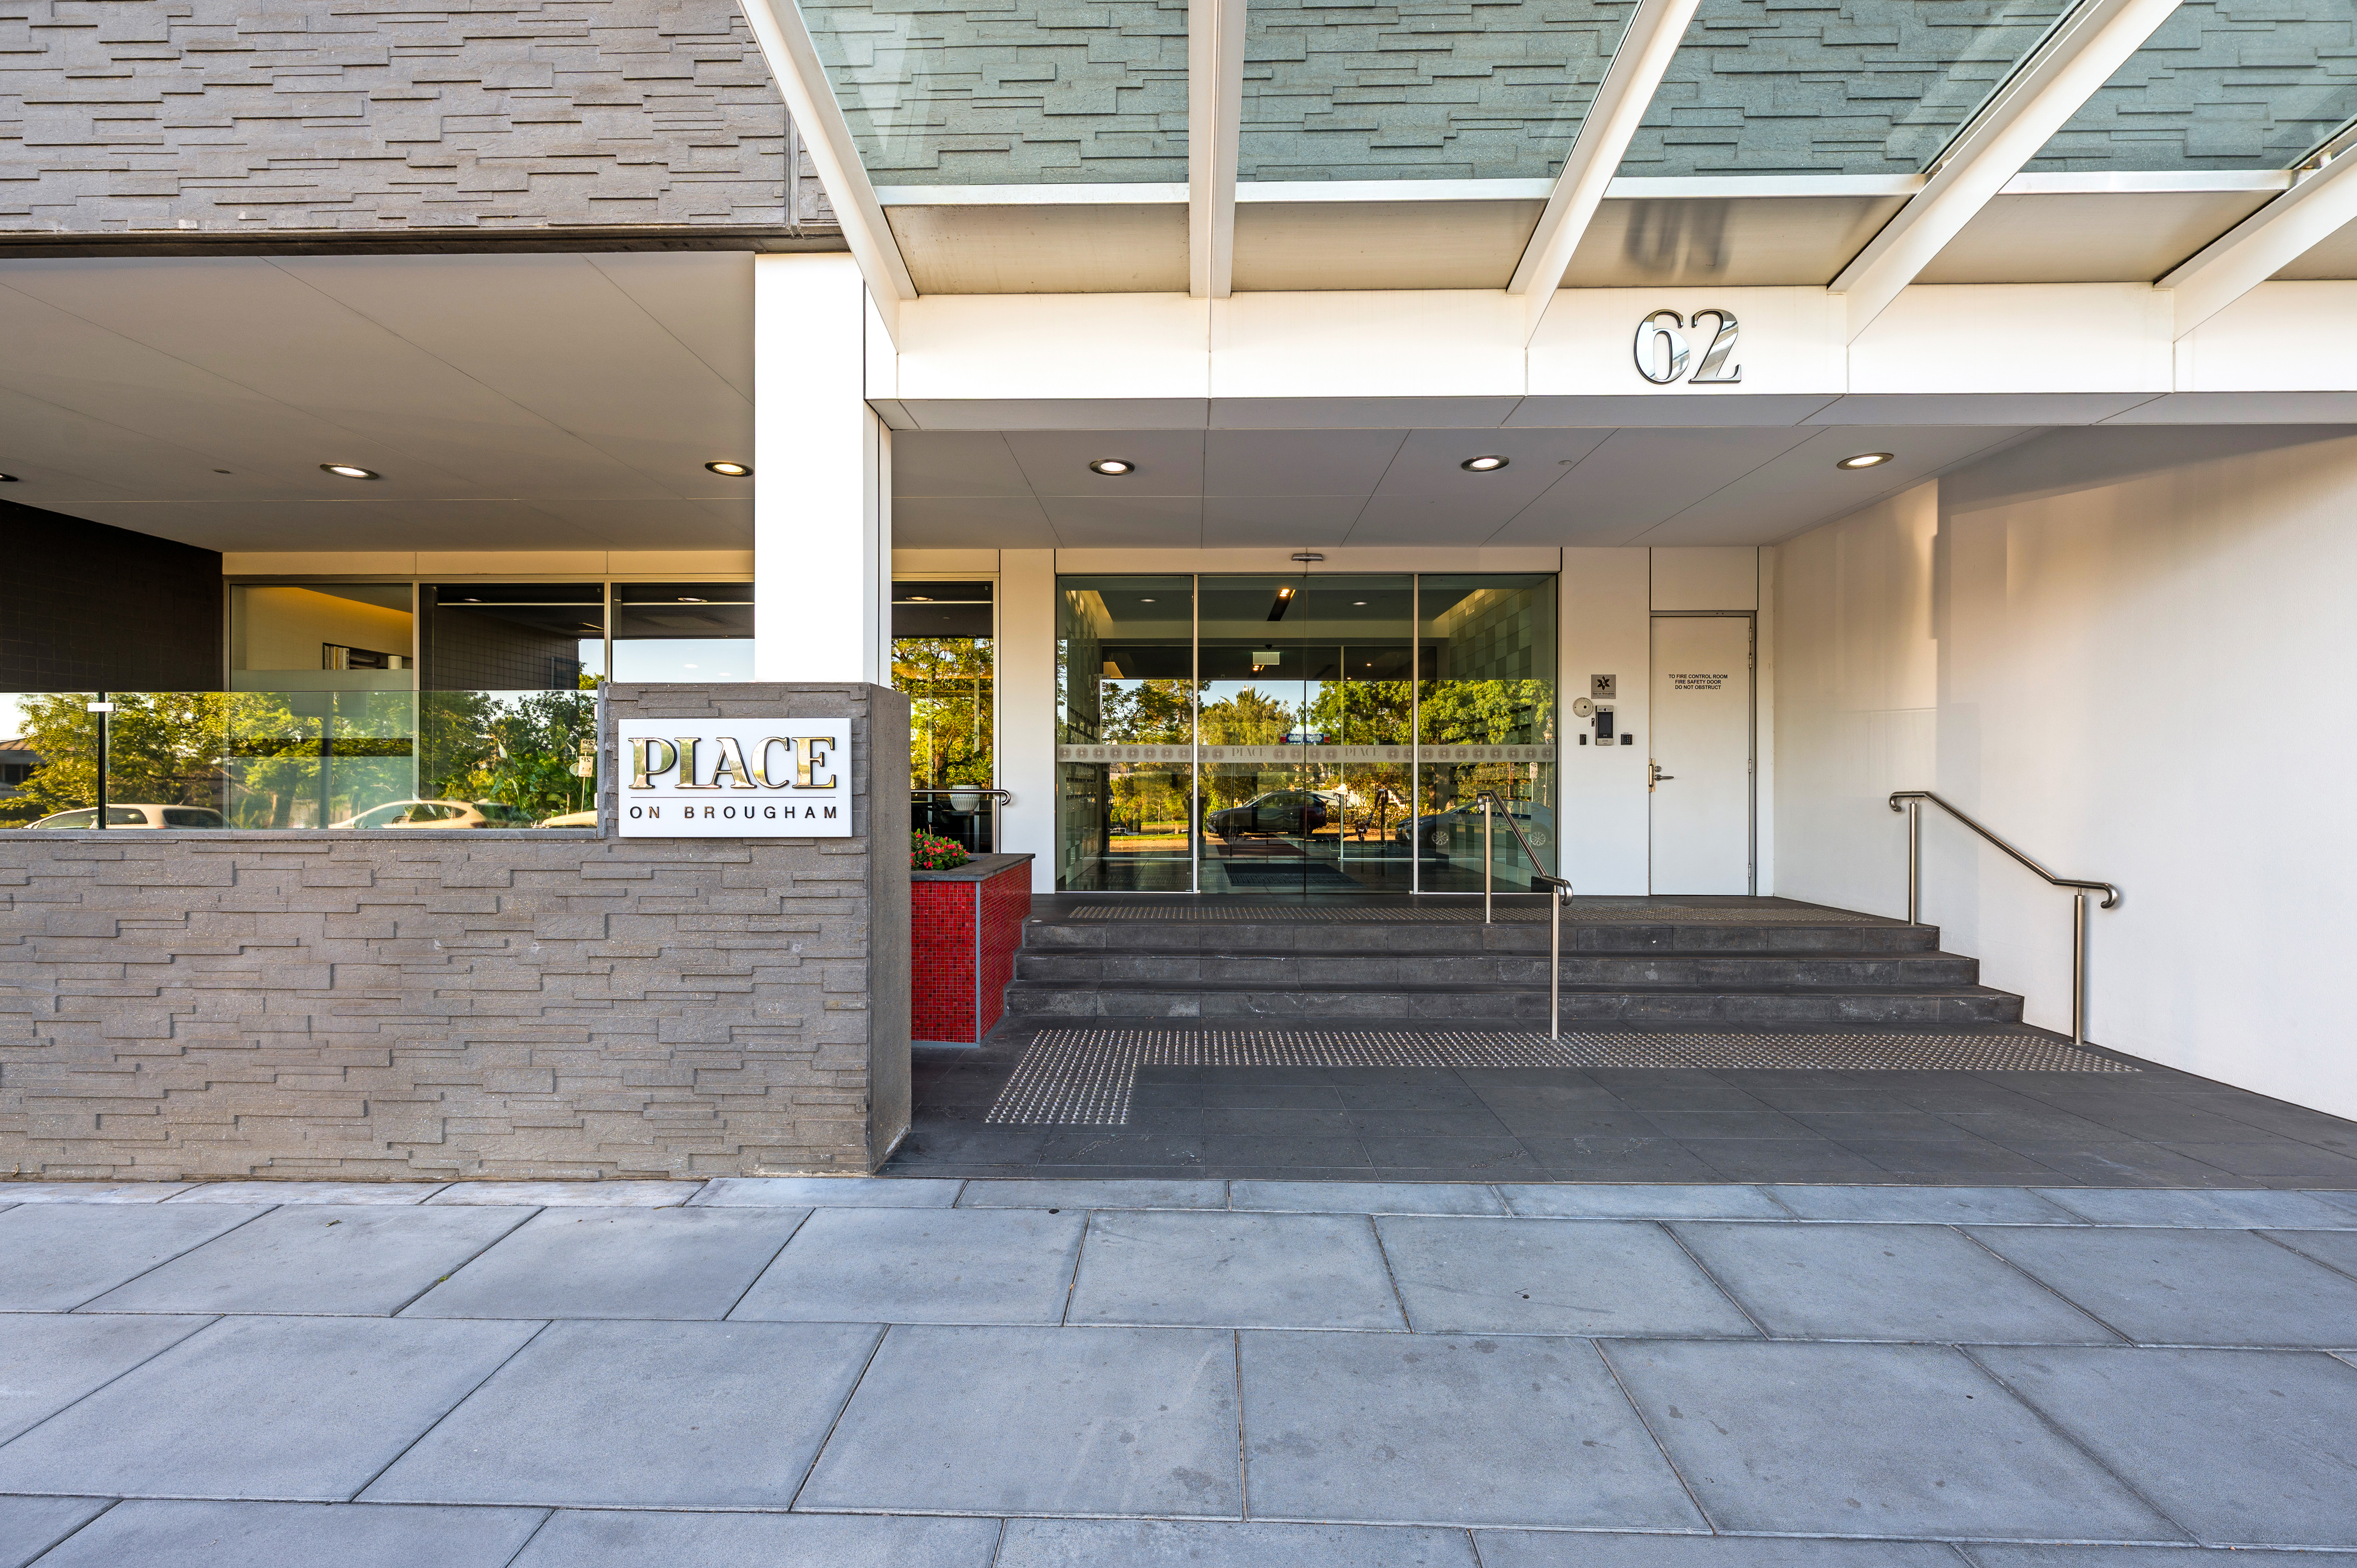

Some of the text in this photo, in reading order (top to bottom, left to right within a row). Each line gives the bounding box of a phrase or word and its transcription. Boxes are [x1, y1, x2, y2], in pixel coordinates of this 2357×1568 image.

[1634, 309, 1741, 384] 62
[1232, 748, 1266, 756] PLACE
[1345, 748, 1380, 756] PLACE
[628, 737, 836, 788] PLACE
[630, 806, 836, 818] ON BROUGHAM
